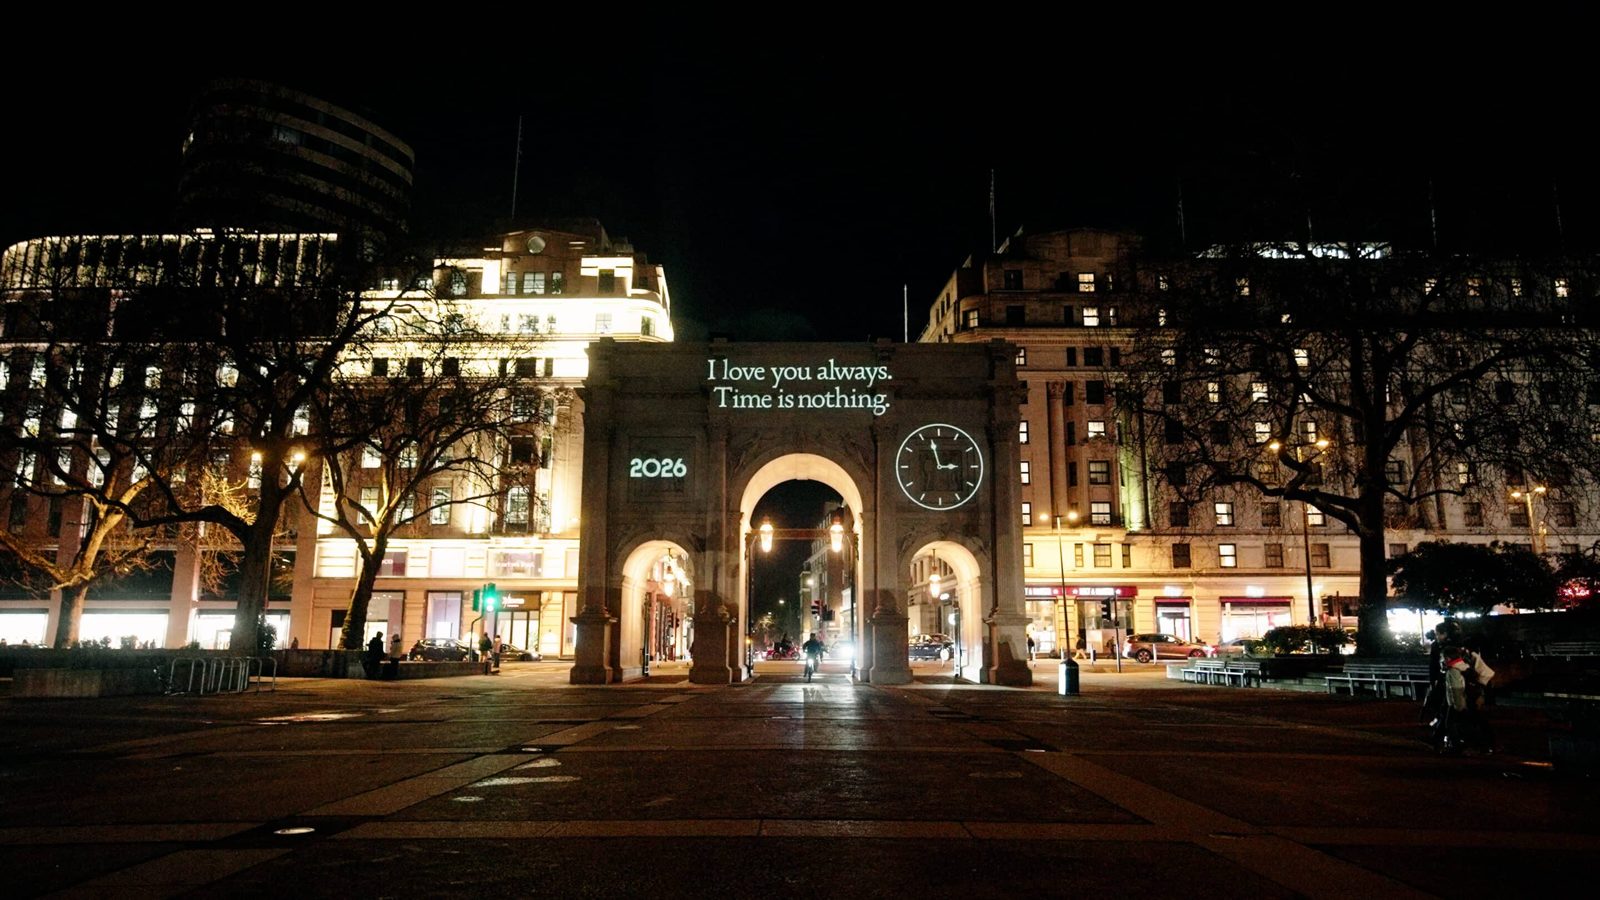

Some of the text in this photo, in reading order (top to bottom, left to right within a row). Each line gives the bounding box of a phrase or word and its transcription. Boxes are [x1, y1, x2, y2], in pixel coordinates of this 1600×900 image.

[708, 358, 893, 387] I love you always.
[713, 385, 891, 416] Time is nothing.
[629, 457, 688, 478] 2026
